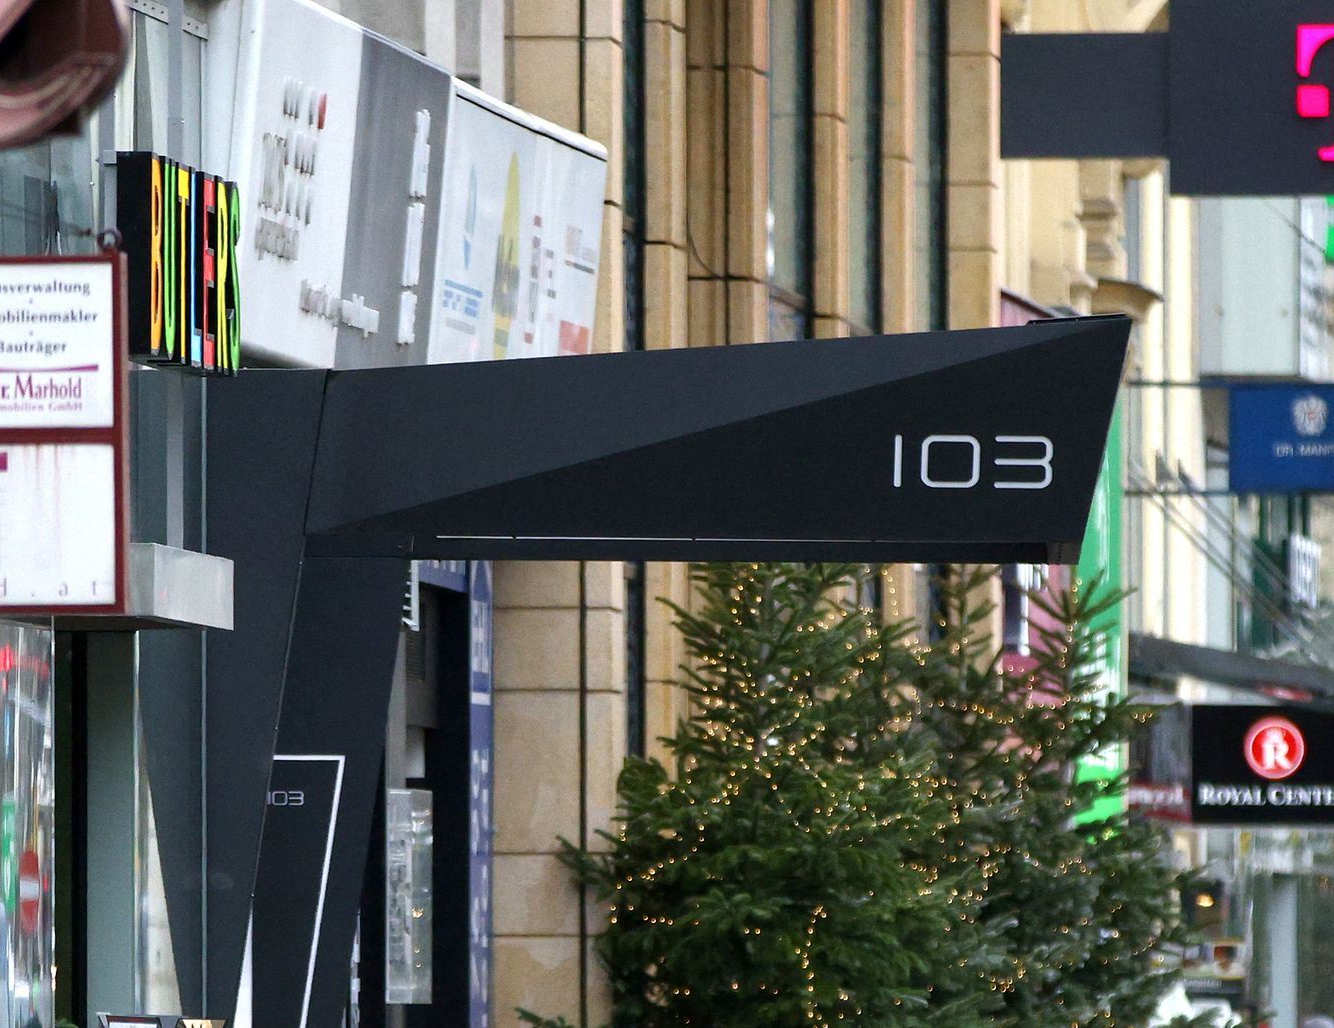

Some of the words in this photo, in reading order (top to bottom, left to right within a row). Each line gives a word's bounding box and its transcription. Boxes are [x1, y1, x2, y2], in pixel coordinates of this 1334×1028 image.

[151, 158, 241, 371] BUTLERS
[14, 374, 82, 399] Marhold
[49, 402, 83, 412] GmbH
[892, 434, 1054, 490] 103
[1198, 783, 1267, 806] ROYAL
